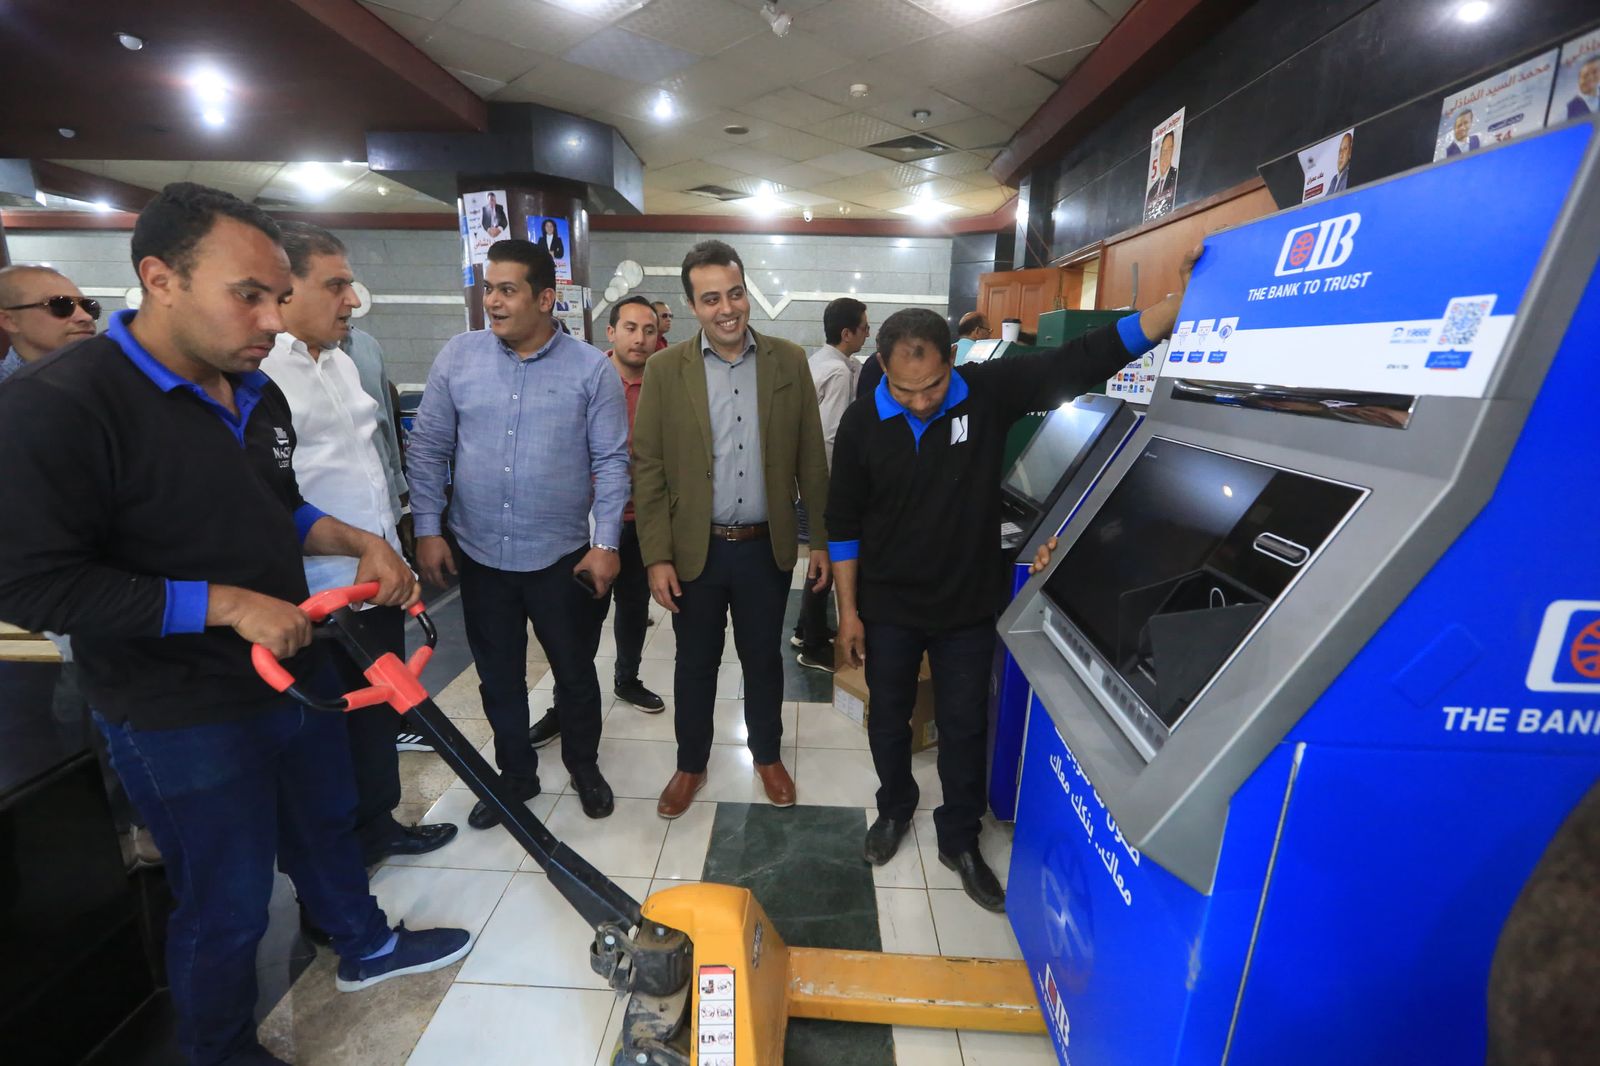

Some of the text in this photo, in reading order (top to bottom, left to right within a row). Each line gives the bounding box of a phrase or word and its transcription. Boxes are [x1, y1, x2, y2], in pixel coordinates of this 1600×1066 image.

[1247, 271, 1373, 301] THE BANK TO TRUST
[1442, 706, 1600, 735] THE BAN
[1050, 754, 1070, 794] معاك
